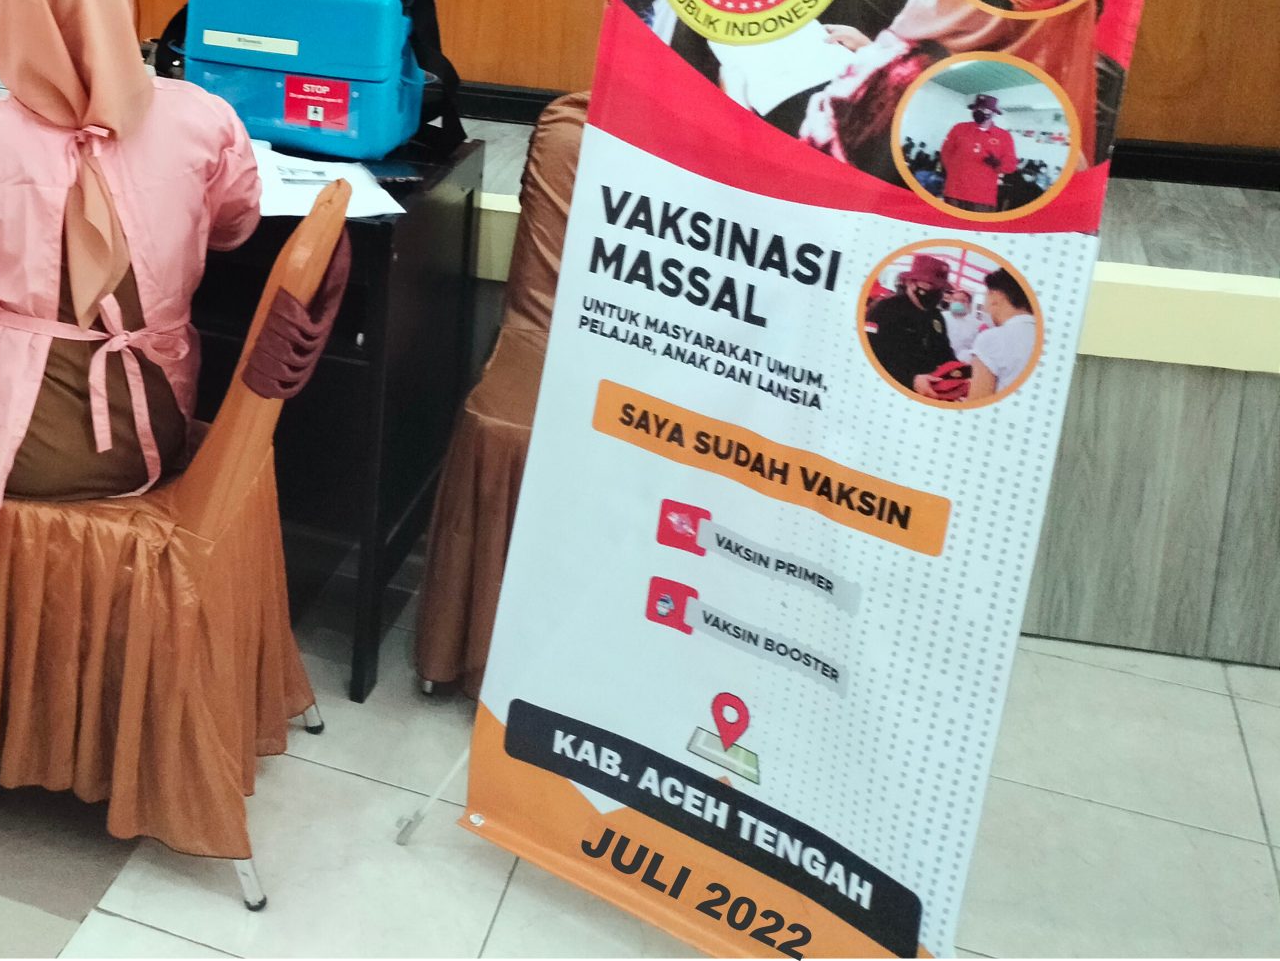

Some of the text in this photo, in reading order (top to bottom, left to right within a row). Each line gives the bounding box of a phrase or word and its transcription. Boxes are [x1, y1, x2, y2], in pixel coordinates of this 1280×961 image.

[302, 83, 330, 95] STOP
[588, 236, 768, 328] MASSAL
[601, 185, 842, 292] VAKSINASI
[578, 314, 822, 412] PELAJAR, ANAK DAN LANSIA
[582, 295, 828, 391] UNTUK MASYARAKAT UMUM,
[618, 402, 912, 530] SAYA SUDAH VAKSIN
[715, 532, 835, 595] VAKSIN PRIMER
[701, 610, 840, 684] VAKSIN BOOSTER
[552, 729, 874, 911] KAB. ACEH TENGAH
[581, 827, 812, 961] JULI 2022
